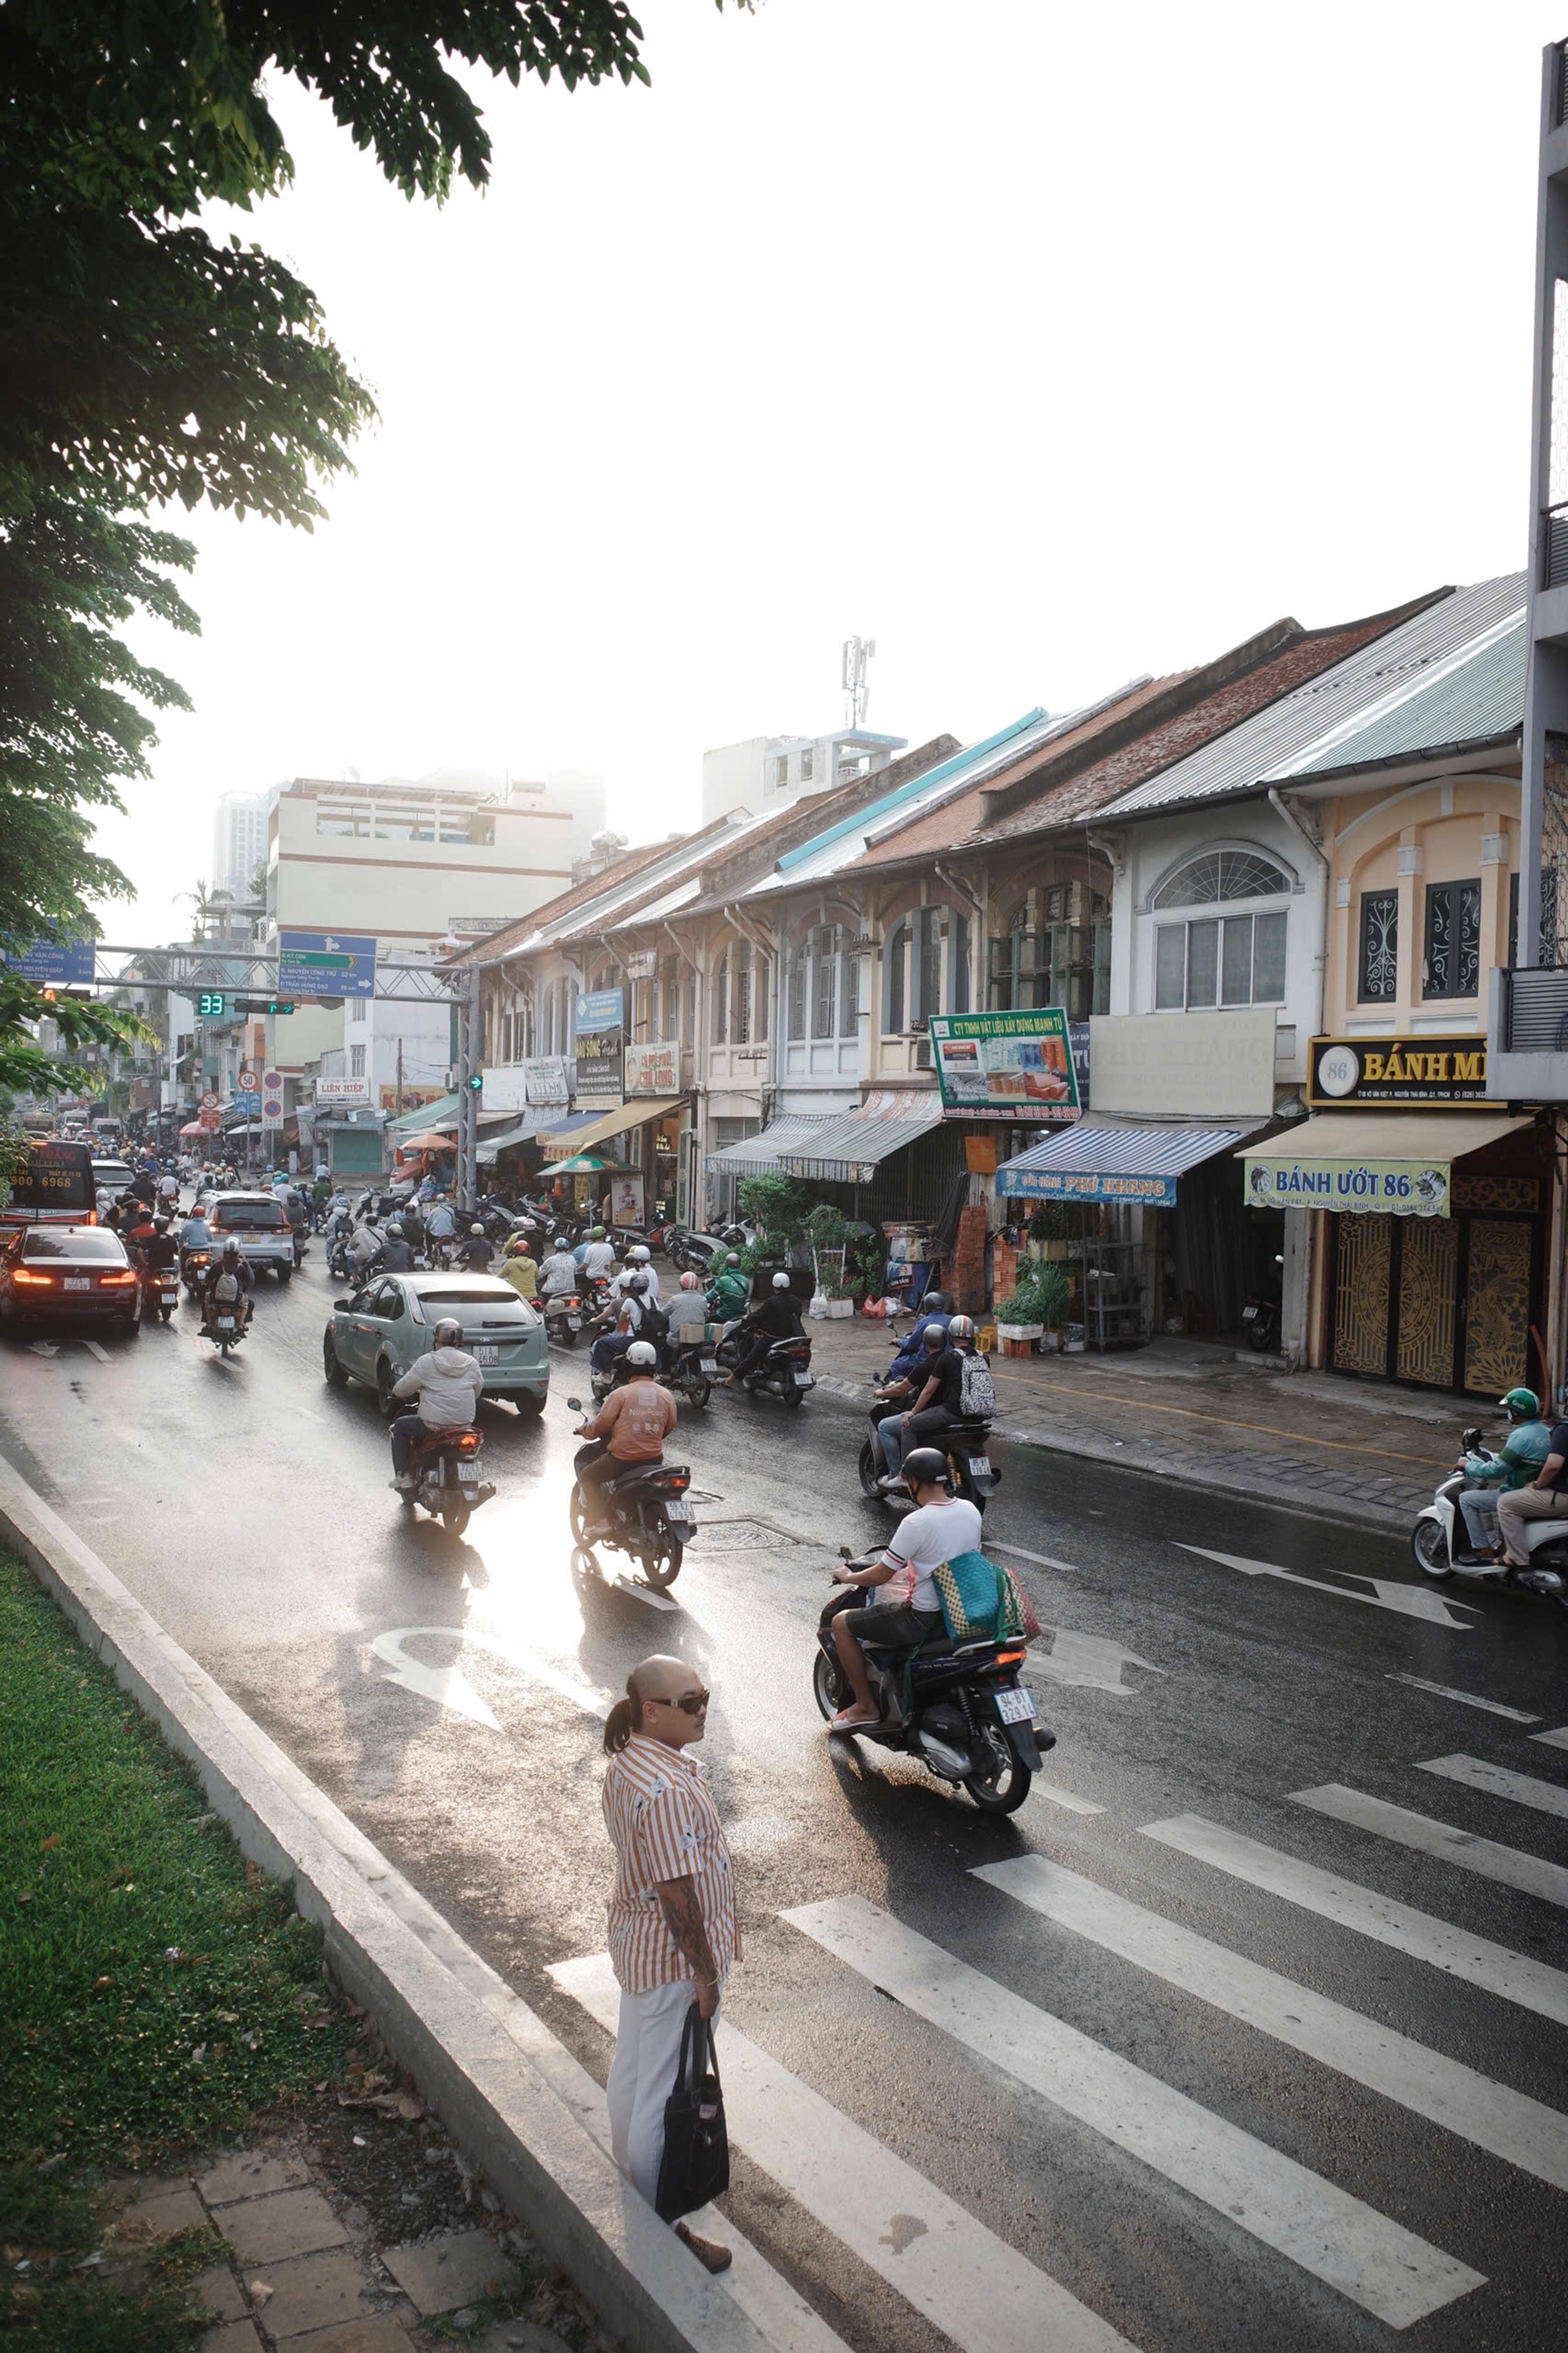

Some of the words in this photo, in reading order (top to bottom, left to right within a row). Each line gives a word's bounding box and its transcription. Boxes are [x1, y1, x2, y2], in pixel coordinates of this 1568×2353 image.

[201, 995, 223, 1014] 33
[1327, 1062, 1347, 1081] 86
[1363, 1043, 1450, 1081] BÁNH
[243, 1076, 253, 1085] 50
[42, 1177, 71, 1188] 6968
[1065, 1174, 1099, 1193] PHÚ
[1102, 1178, 1165, 1197] KHANG
[1276, 1165, 1331, 1193] BÁNH
[1338, 1167, 1379, 1195] ƯỚT
[1383, 1174, 1411, 1197] 86
